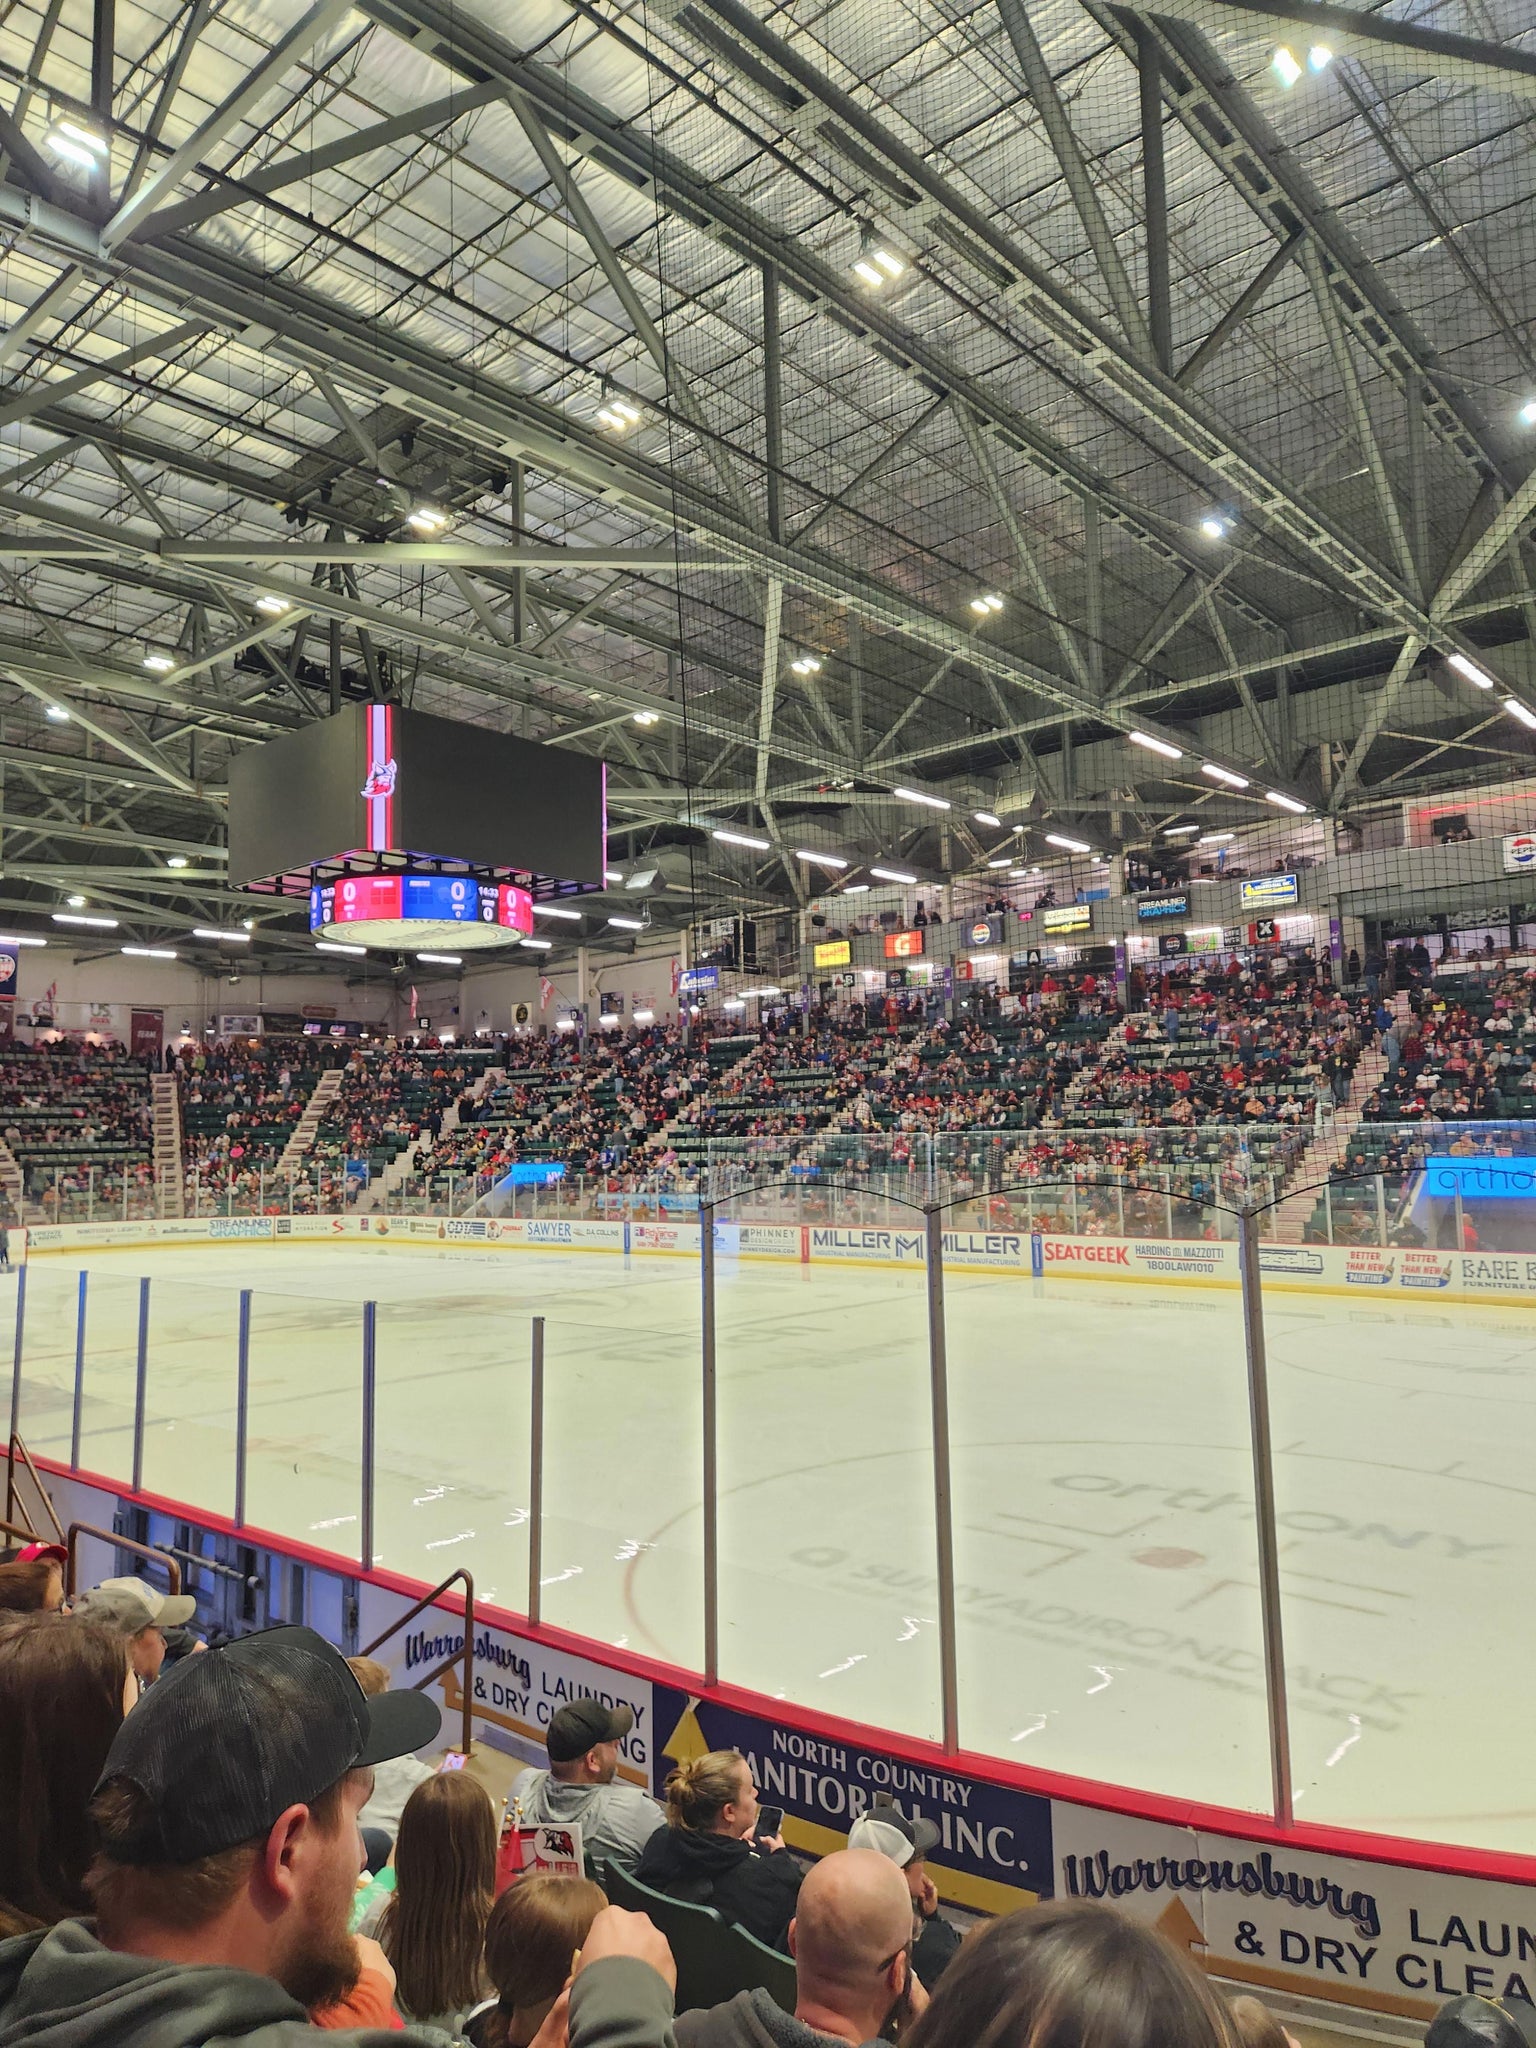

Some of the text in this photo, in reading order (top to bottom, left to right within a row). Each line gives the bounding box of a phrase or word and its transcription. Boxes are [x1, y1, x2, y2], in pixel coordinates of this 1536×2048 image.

[343, 882, 356, 902] 0
[450, 881, 465, 901] 0
[506, 890, 517, 909] 0
[1138, 896, 1186, 910] STREAMLINED
[483, 907, 493, 922] 0
[1138, 903, 1187, 918] GRAPHICS
[1259, 922, 1272, 935] X
[894, 933, 911, 957] G
[1028, 951, 1038, 963] A
[421, 1019, 429, 1028] E
[1438, 1164, 1534, 1190] ortho
[210, 1219, 272, 1228] STREAMLINED
[527, 1221, 572, 1237] SAWYER
[209, 1226, 272, 1238] GRAPHICS
[750, 1229, 796, 1239] PHINNEY
[813, 1229, 891, 1249] MILLER
[1044, 1242, 1131, 1266] SEATGEEK
[1135, 1244, 1224, 1259] HARDING MAZZOTTI
[1350, 1251, 1381, 1262] BETTER
[1405, 1253, 1437, 1264] BETTER
[1146, 1260, 1214, 1274] 1800LAW1010
[1346, 1261, 1385, 1273] THAN NEW
[1400, 1264, 1441, 1275] THAN NEW
[1462, 1259, 1519, 1280] BARE
[1349, 1273, 1385, 1285] PAINTING
[1403, 1275, 1440, 1288] PAINTING
[1462, 1281, 1526, 1290] FURNITURE
[405, 1630, 532, 1692] Warresburg
[474, 1676, 530, 1716] & DRY
[772, 1730, 973, 1808] NORTH COUNTRY
[941, 1812, 1029, 1872] INC.
[1064, 1849, 1382, 1941] Warrensburg
[1234, 1920, 1266, 1957] &
[1279, 1928, 1378, 1978] DRY
